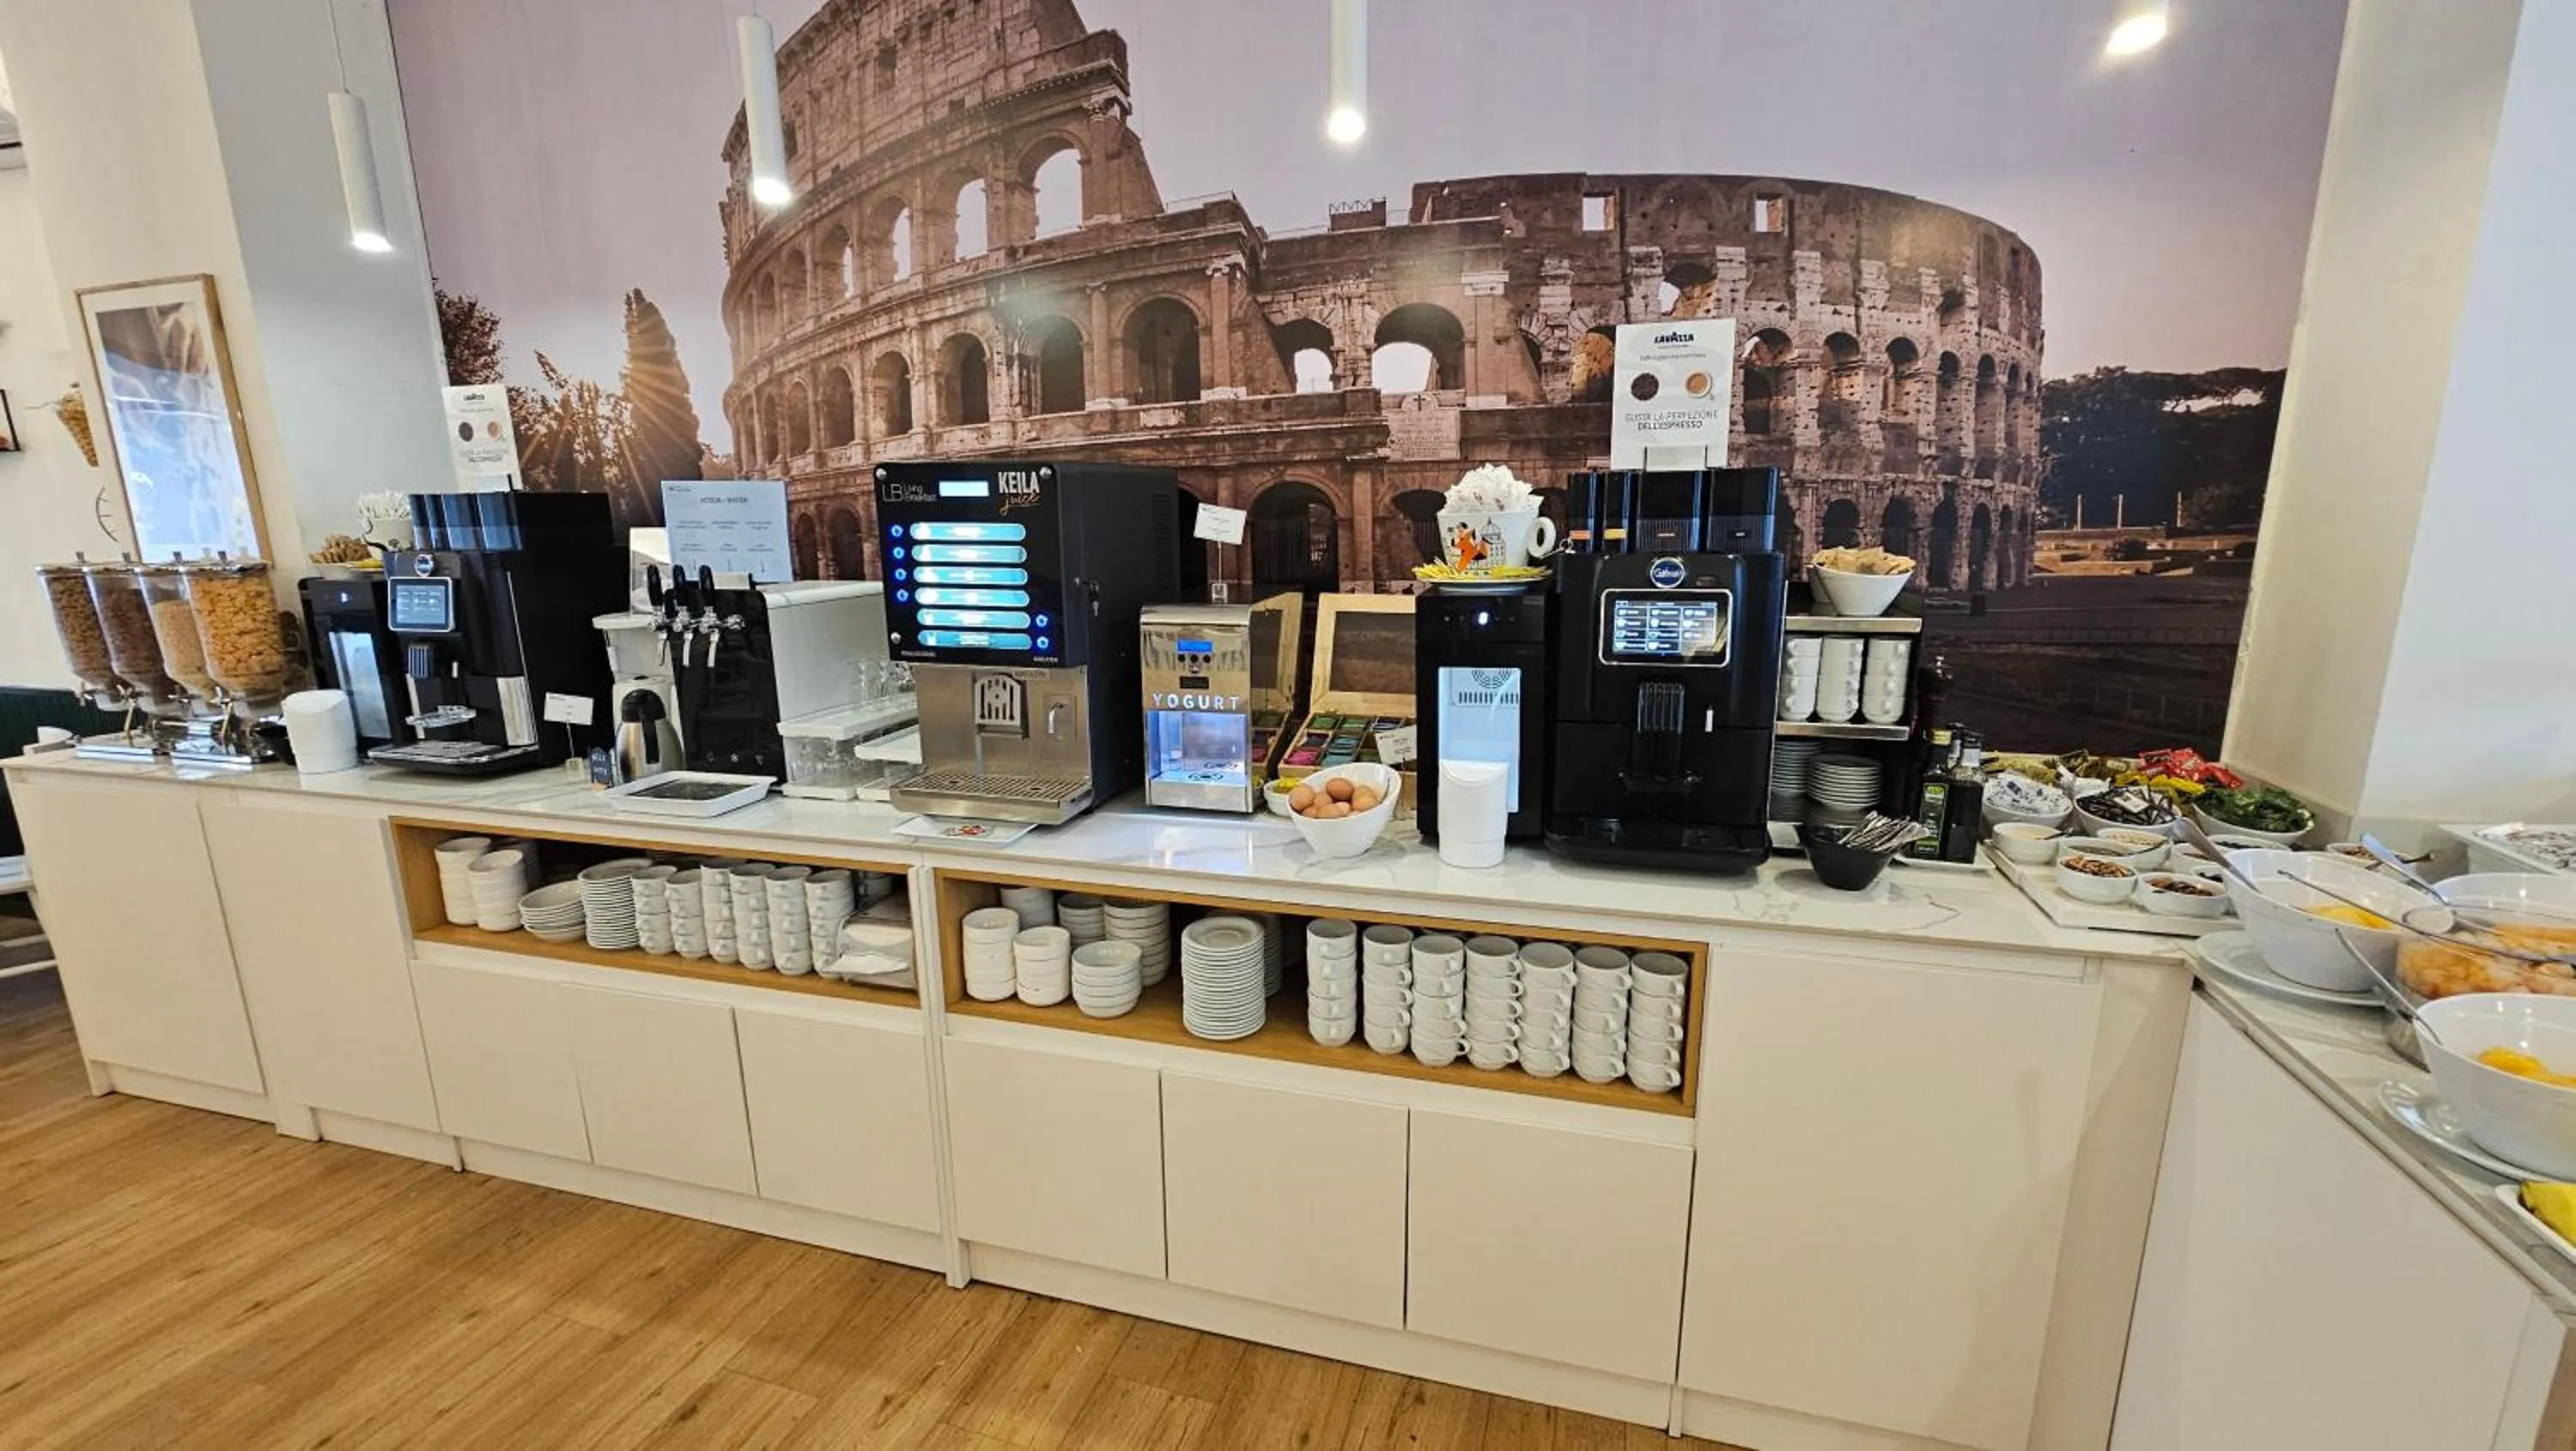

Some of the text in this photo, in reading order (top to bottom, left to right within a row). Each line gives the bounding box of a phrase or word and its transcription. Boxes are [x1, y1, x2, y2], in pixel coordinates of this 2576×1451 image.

[1654, 332, 1694, 343] LAVAZZA
[998, 471, 1040, 494] KEILA
[999, 492, 1042, 515] juice
[1153, 693, 1240, 711] YOGURT
